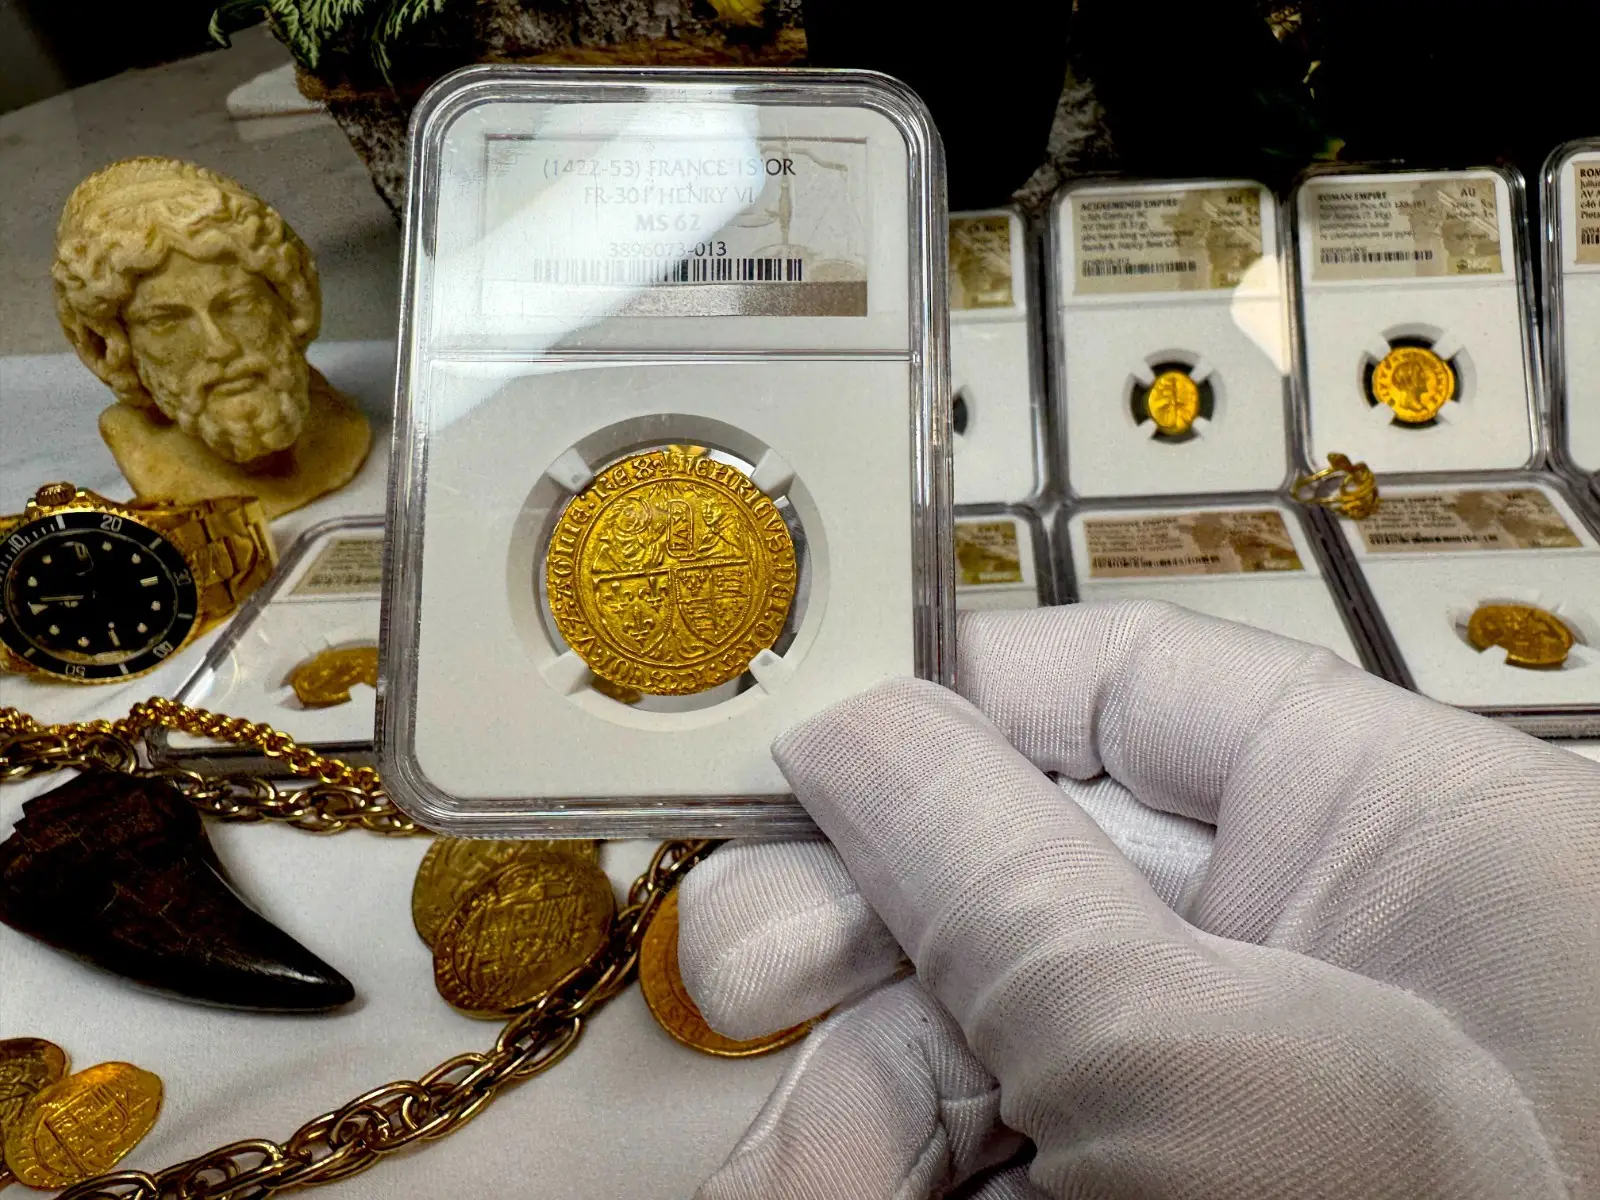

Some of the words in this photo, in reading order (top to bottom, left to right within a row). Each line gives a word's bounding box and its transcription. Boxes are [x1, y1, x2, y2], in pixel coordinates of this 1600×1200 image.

[649, 159, 729, 176] FRANCE
[659, 186, 726, 204] HENRY
[734, 186, 755, 204] VI
[1461, 187, 1476, 197] AU
[636, 213, 669, 232] MS
[674, 213, 701, 231] 62
[100, 514, 123, 533] 20
[8, 533, 28, 552] 10
